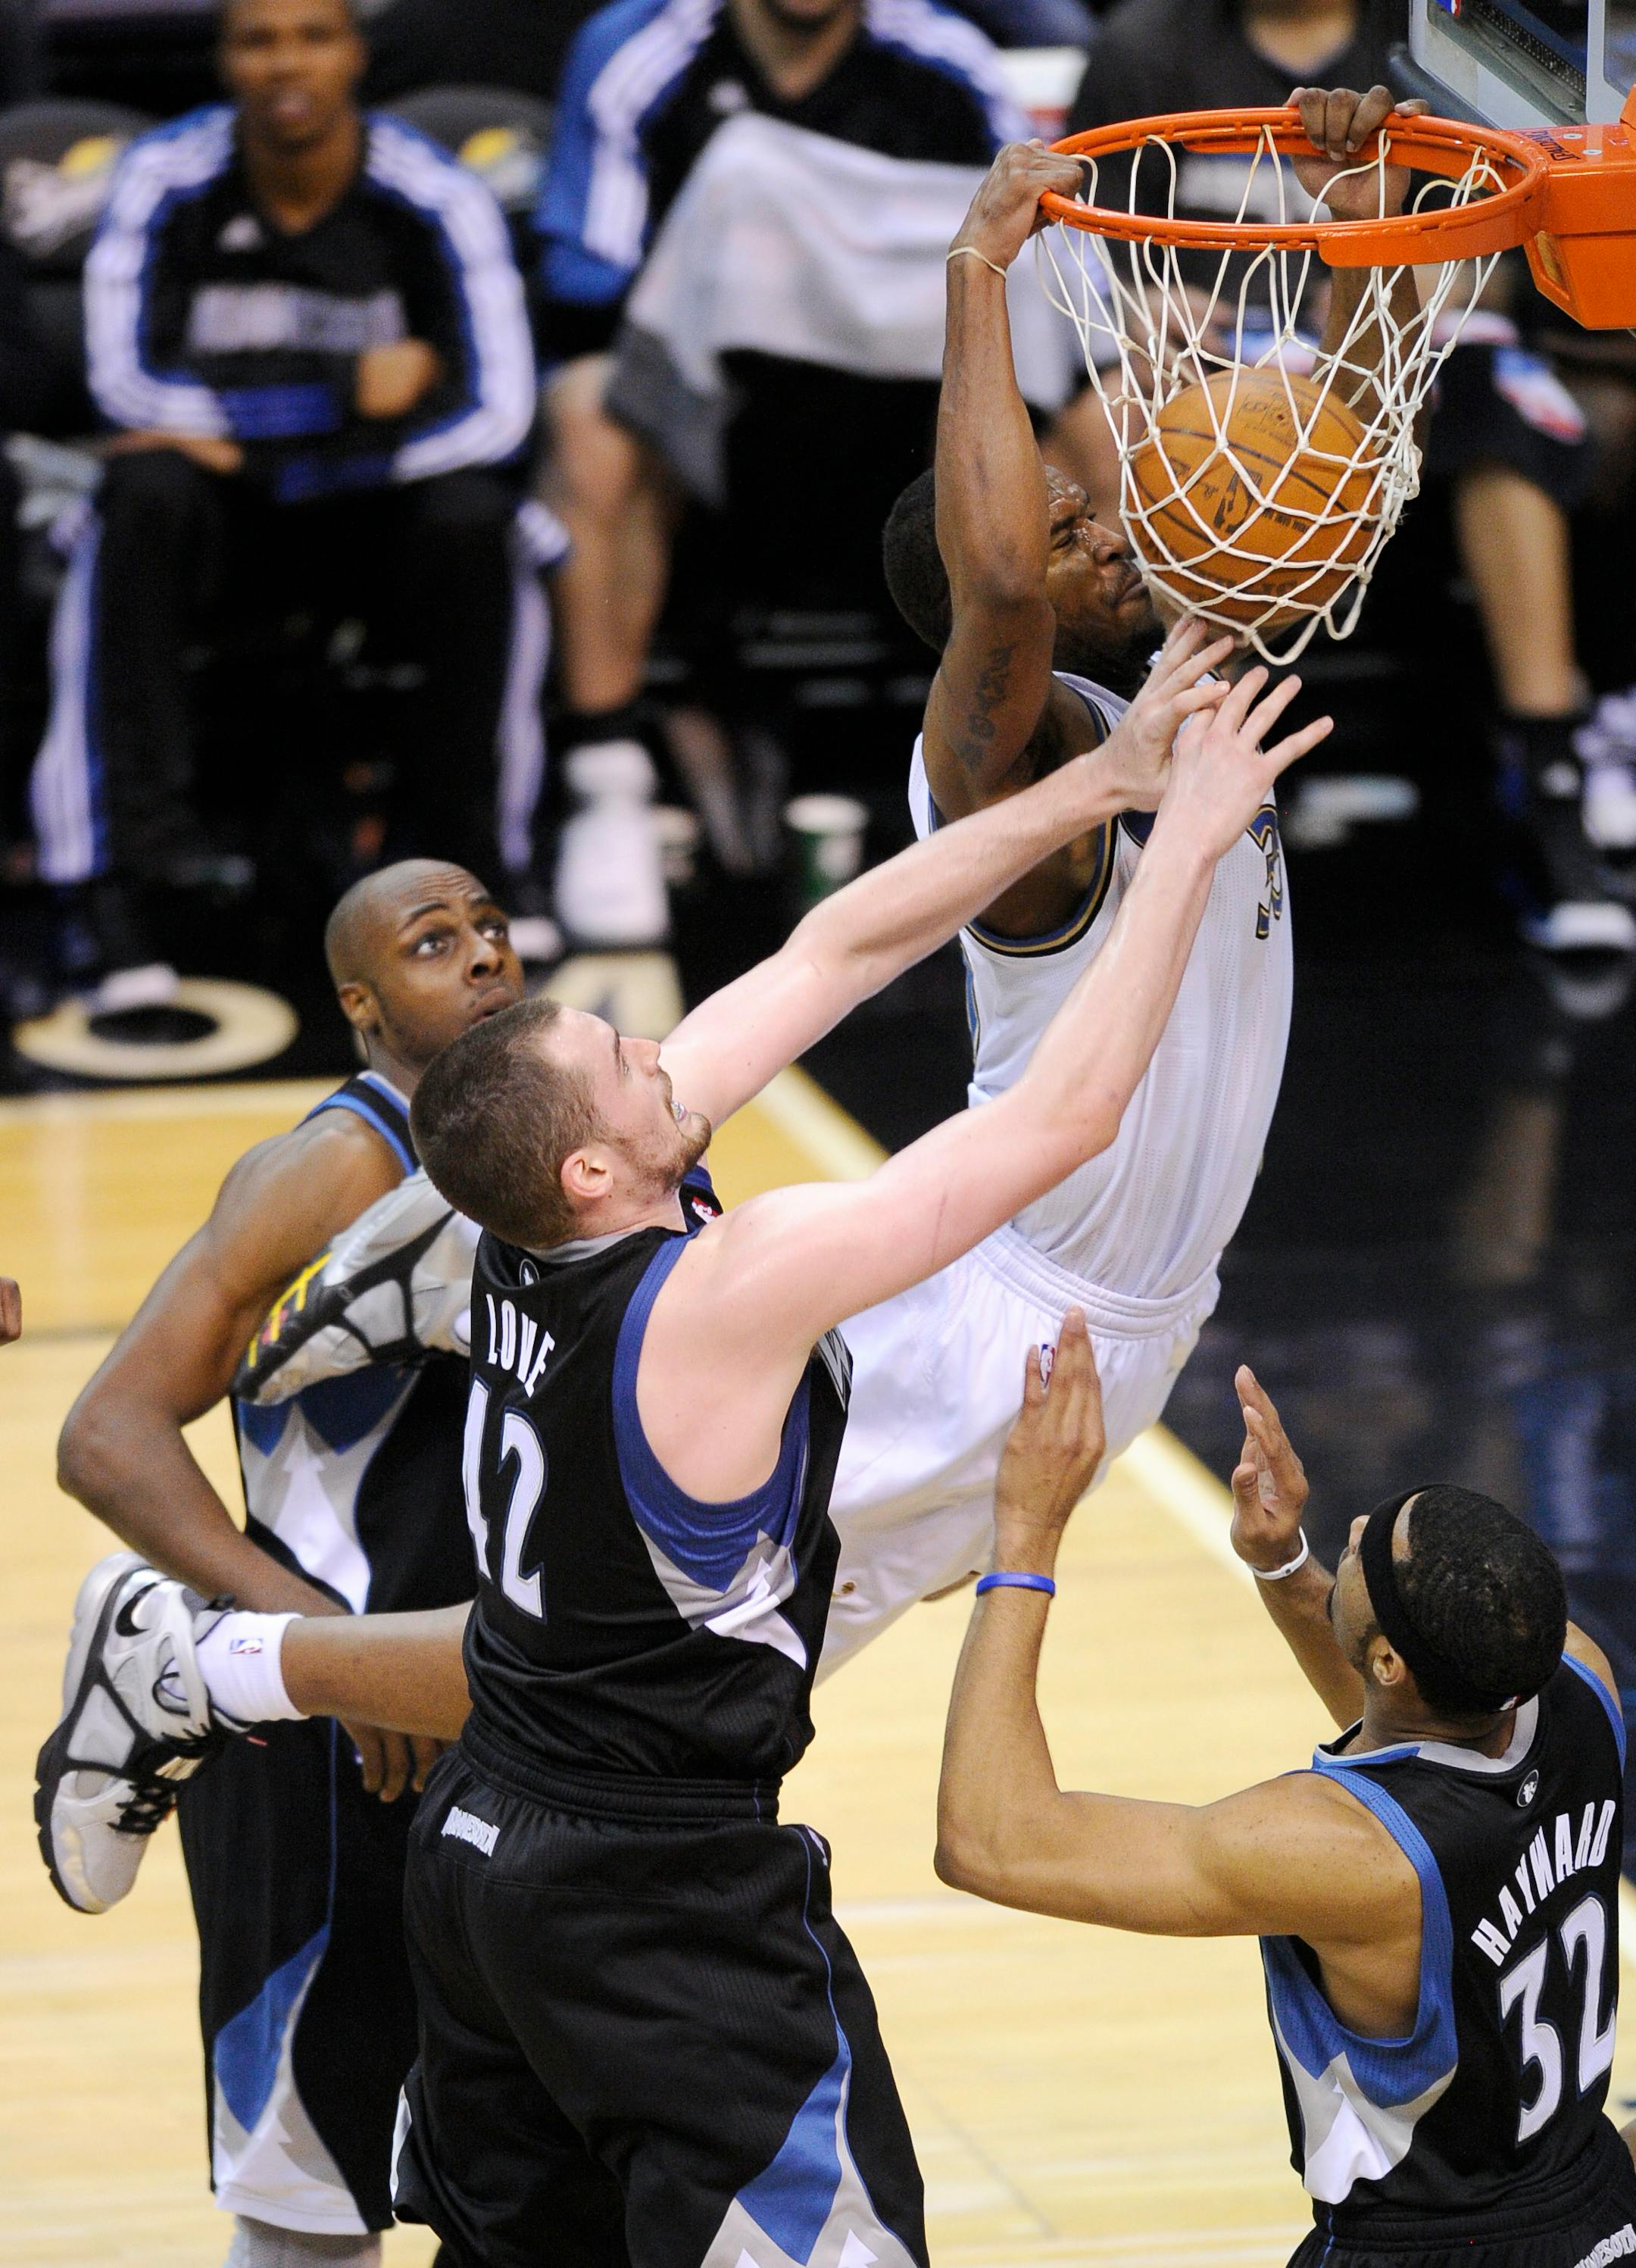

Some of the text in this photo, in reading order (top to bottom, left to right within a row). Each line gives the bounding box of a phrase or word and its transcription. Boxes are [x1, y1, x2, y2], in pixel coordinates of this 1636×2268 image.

[485, 1293, 556, 1398] LOVE
[1471, 1799, 1616, 1967] HAYWARD
[1497, 1892, 1617, 2146] 32
